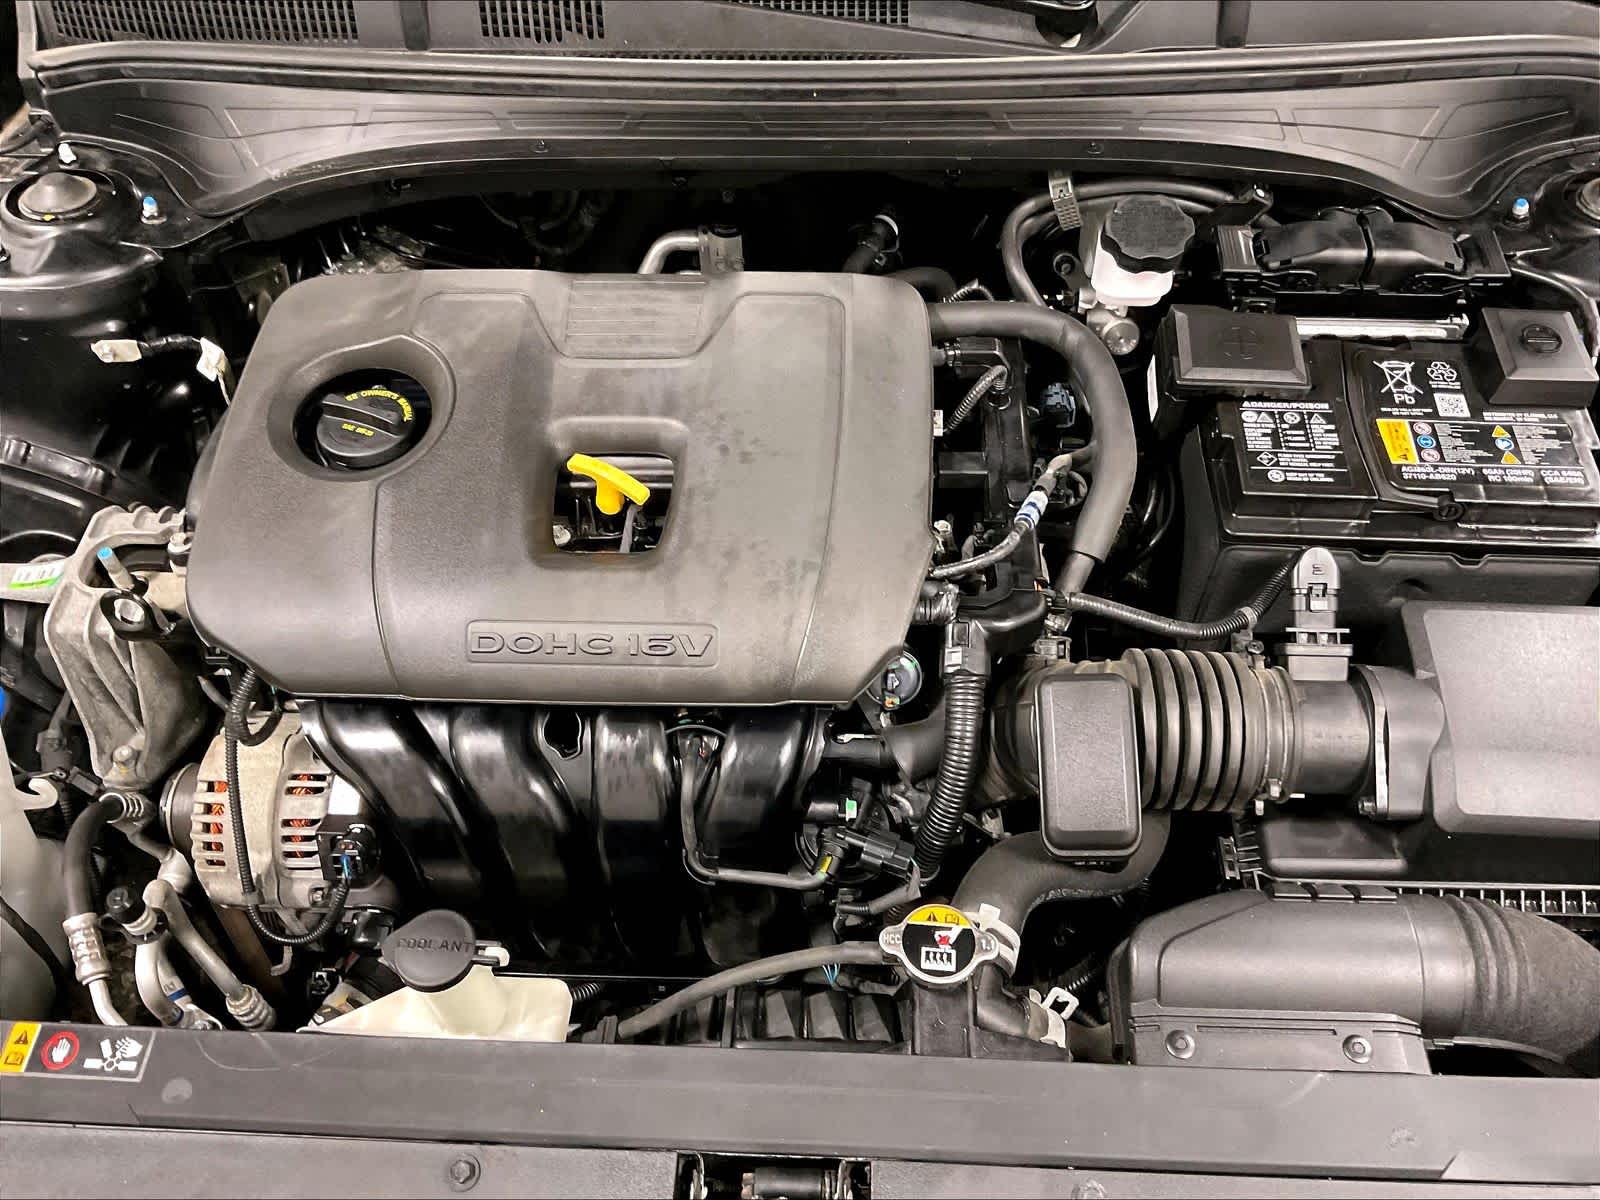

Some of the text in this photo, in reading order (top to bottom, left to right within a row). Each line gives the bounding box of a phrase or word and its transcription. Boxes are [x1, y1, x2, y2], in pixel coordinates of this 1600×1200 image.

[1393, 393, 1416, 404] Pb
[470, 631, 714, 657] DOHC 16V
[397, 937, 472, 953] COOLANT
[981, 938, 994, 951] 1.1
